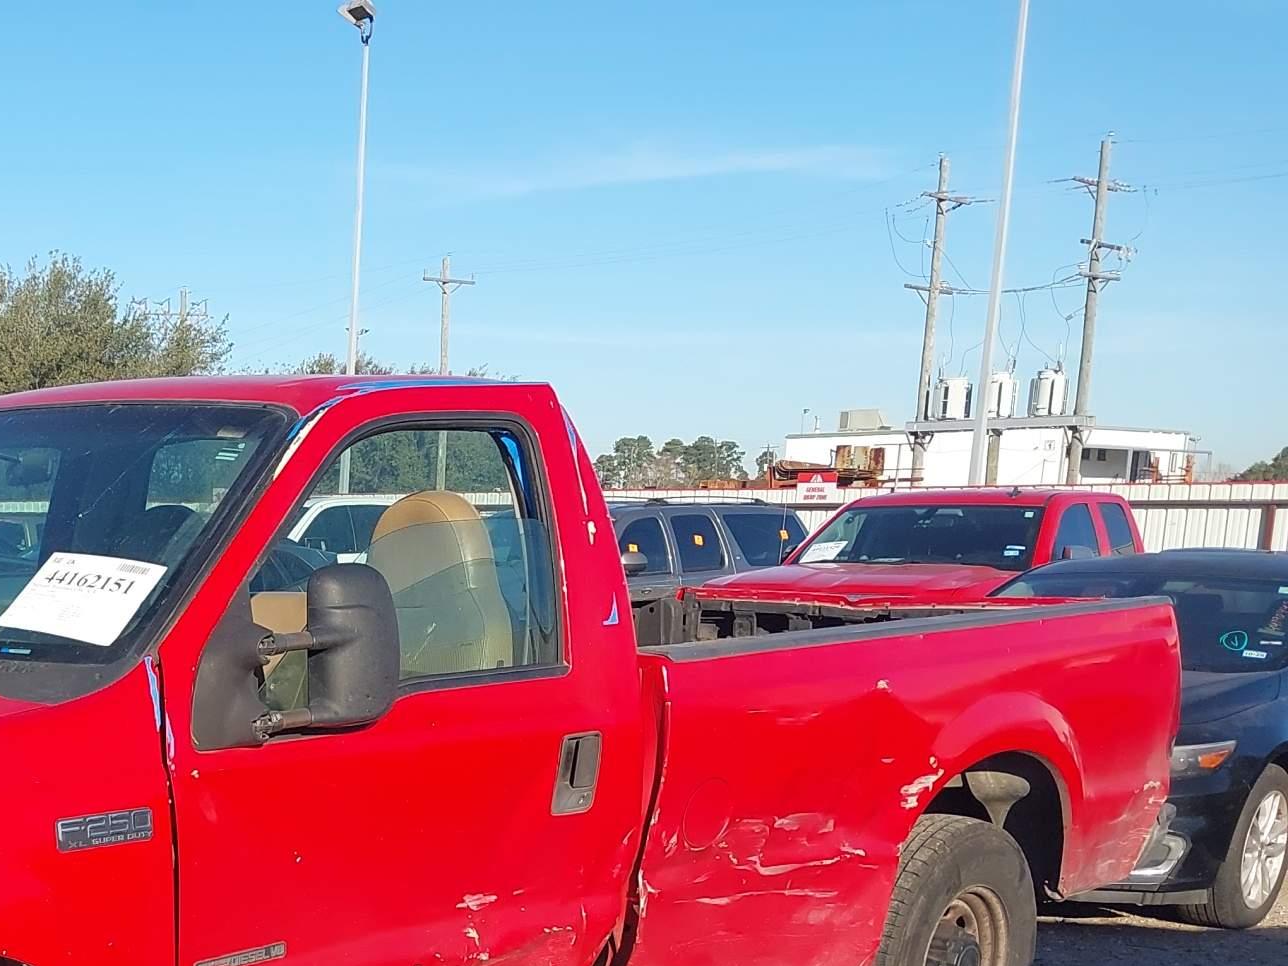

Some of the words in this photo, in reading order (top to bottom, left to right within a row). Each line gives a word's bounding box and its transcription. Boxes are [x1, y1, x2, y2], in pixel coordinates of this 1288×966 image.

[44, 569, 136, 595] 44162151
[92, 834, 125, 845] SUPER
[127, 830, 153, 840] DUTY
[230, 947, 270, 966] DIESEL
